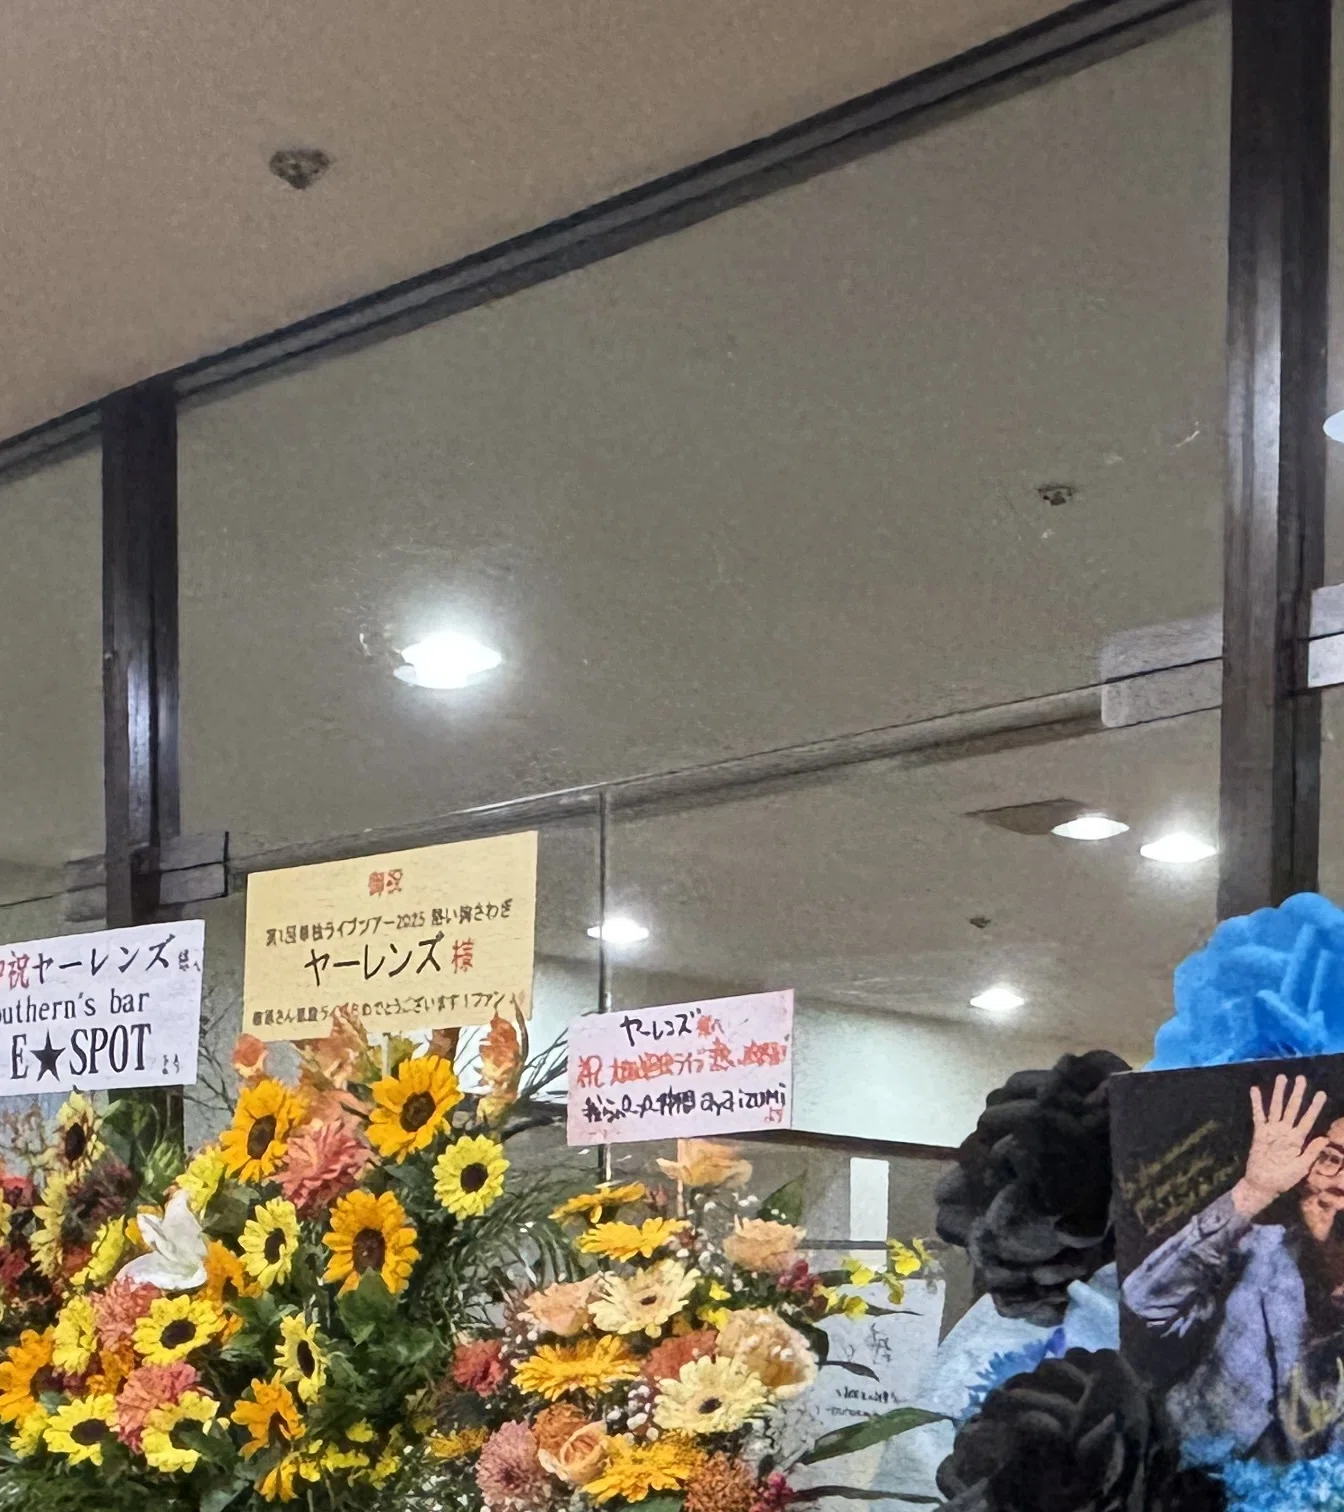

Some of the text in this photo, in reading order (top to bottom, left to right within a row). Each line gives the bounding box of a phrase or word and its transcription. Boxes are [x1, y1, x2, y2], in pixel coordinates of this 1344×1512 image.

[304, 930, 445, 988] ヤーレンズ
[110, 988, 150, 1014] bar
